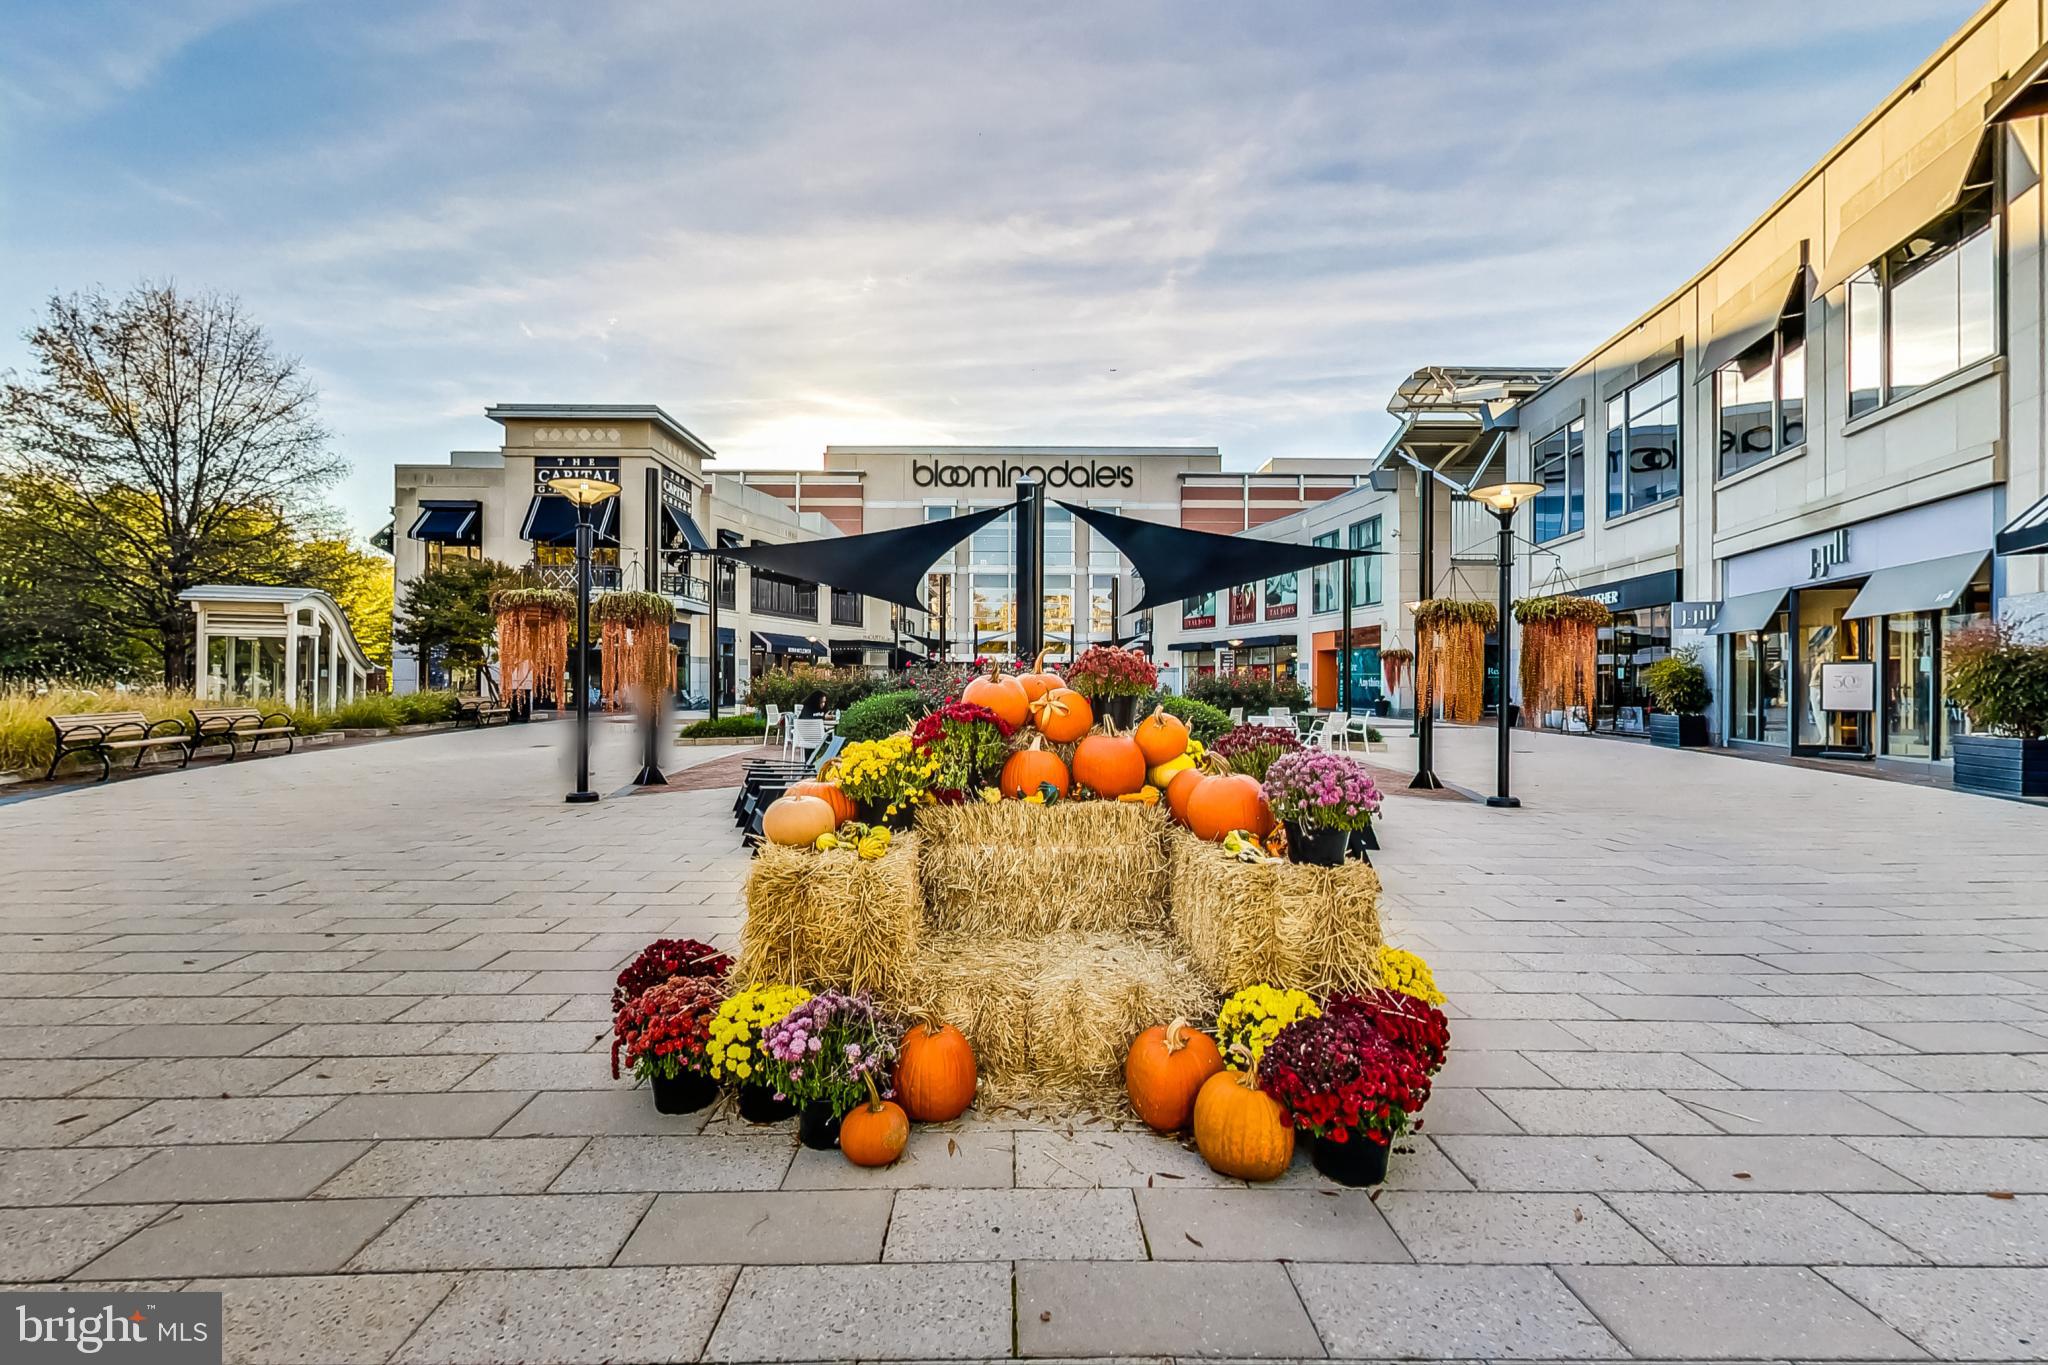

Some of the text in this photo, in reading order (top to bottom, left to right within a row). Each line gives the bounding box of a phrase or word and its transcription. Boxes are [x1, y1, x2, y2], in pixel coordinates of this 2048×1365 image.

[557, 458, 595, 466] THE
[663, 479, 691, 504] CAPITAL
[1268, 607, 1295, 616] TALBOTS
[1188, 618, 1212, 627] TALBOTS
